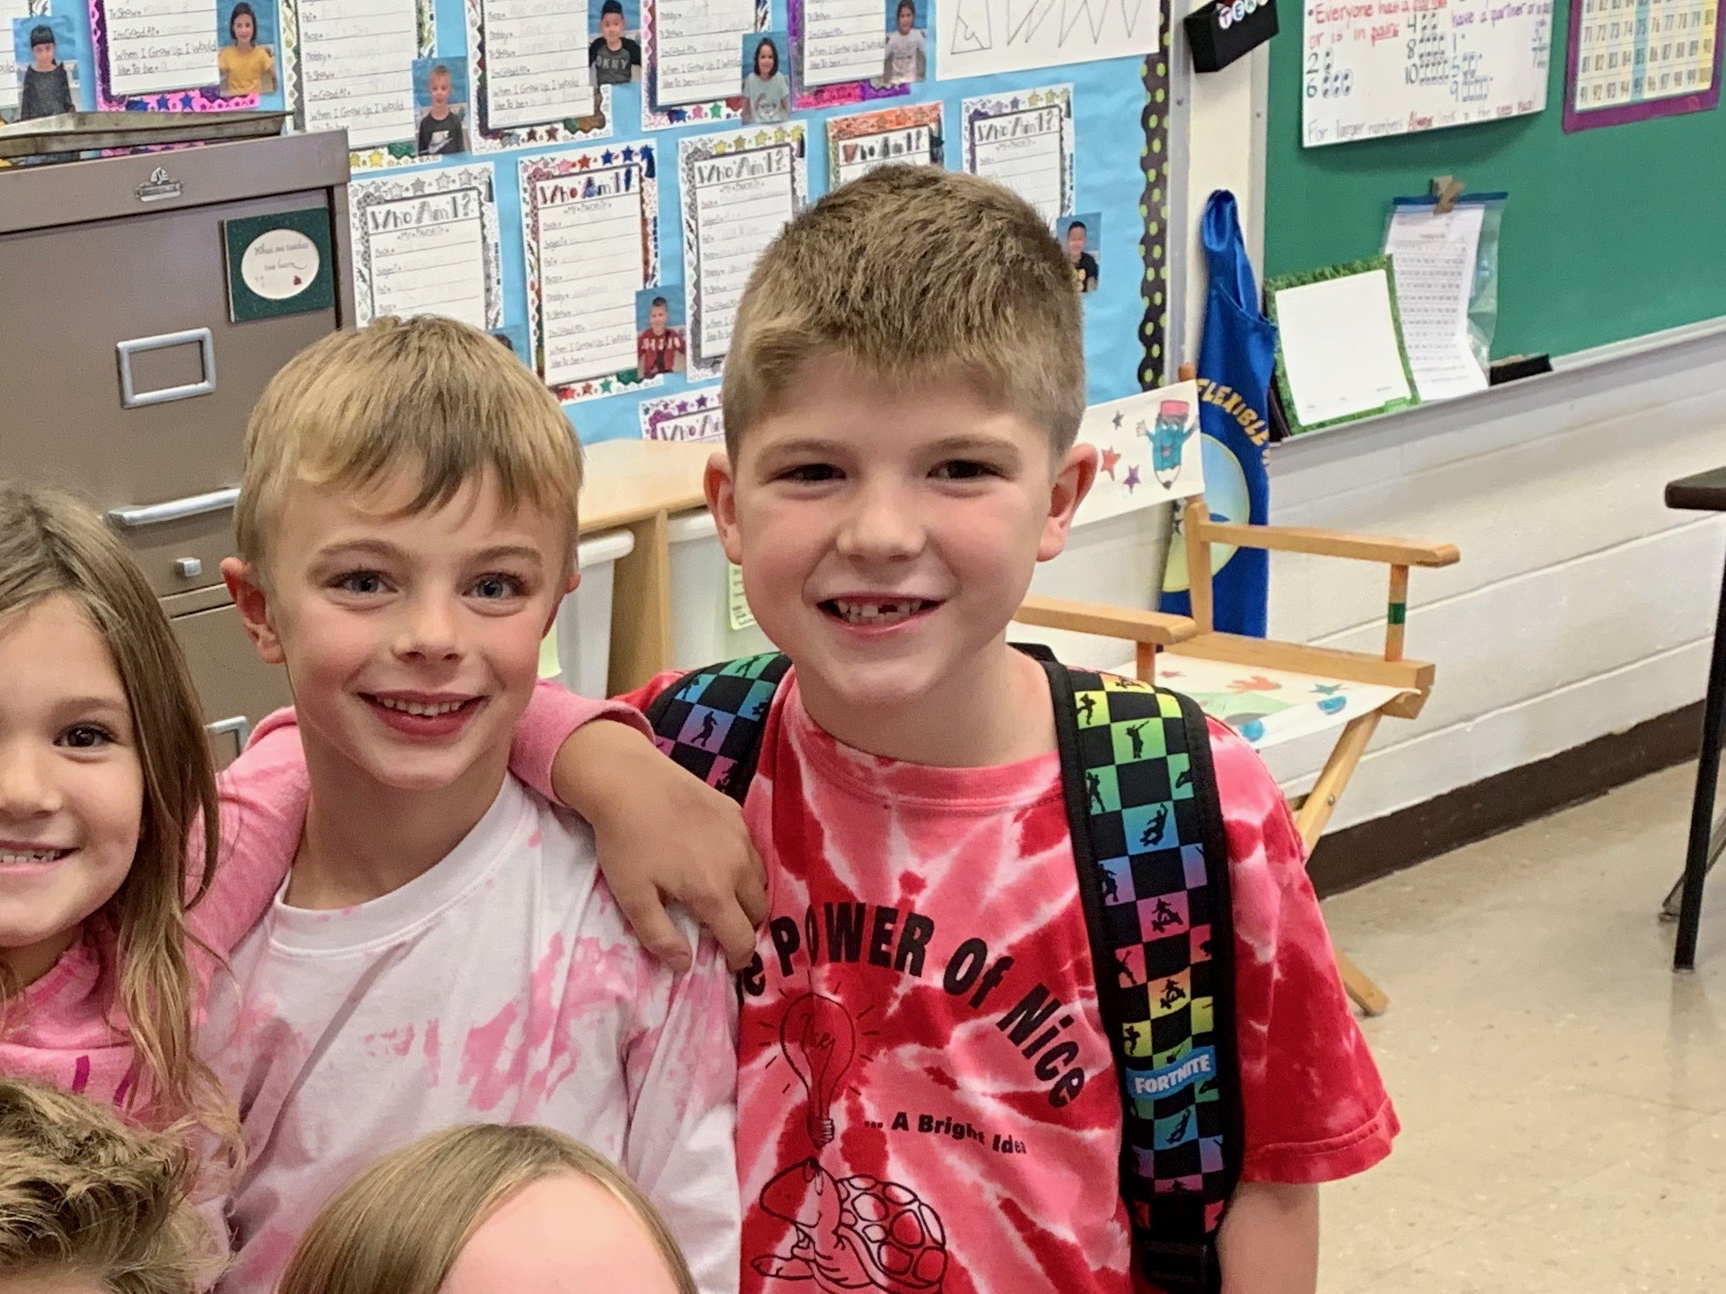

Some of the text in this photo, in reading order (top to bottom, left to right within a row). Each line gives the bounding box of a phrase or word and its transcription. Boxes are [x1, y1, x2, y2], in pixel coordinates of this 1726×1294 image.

[1316, 2, 1372, 28] Everyone
[1407, 14, 1417, 34] 4
[1309, 32, 1324, 50] or
[1407, 38, 1417, 59] 8
[1306, 52, 1319, 75] 2
[1405, 63, 1419, 85] 10
[1306, 77, 1318, 98] 6
[977, 124, 1009, 141] Who
[698, 165, 733, 184] Who
[736, 157, 764, 178] Am
[539, 185, 578, 204] Who
[581, 176, 612, 199] Am
[370, 209, 412, 230] Who
[415, 201, 449, 224] Am
[1196, 378, 1270, 446] FLEXIBLE
[772, 902, 935, 979] POWER
[943, 937, 1015, 1010] Of
[995, 983, 1088, 1110] Nice
[1134, 1054, 1211, 1095] FORTNITE
[891, 1111, 1027, 1154] A Bright Idea
